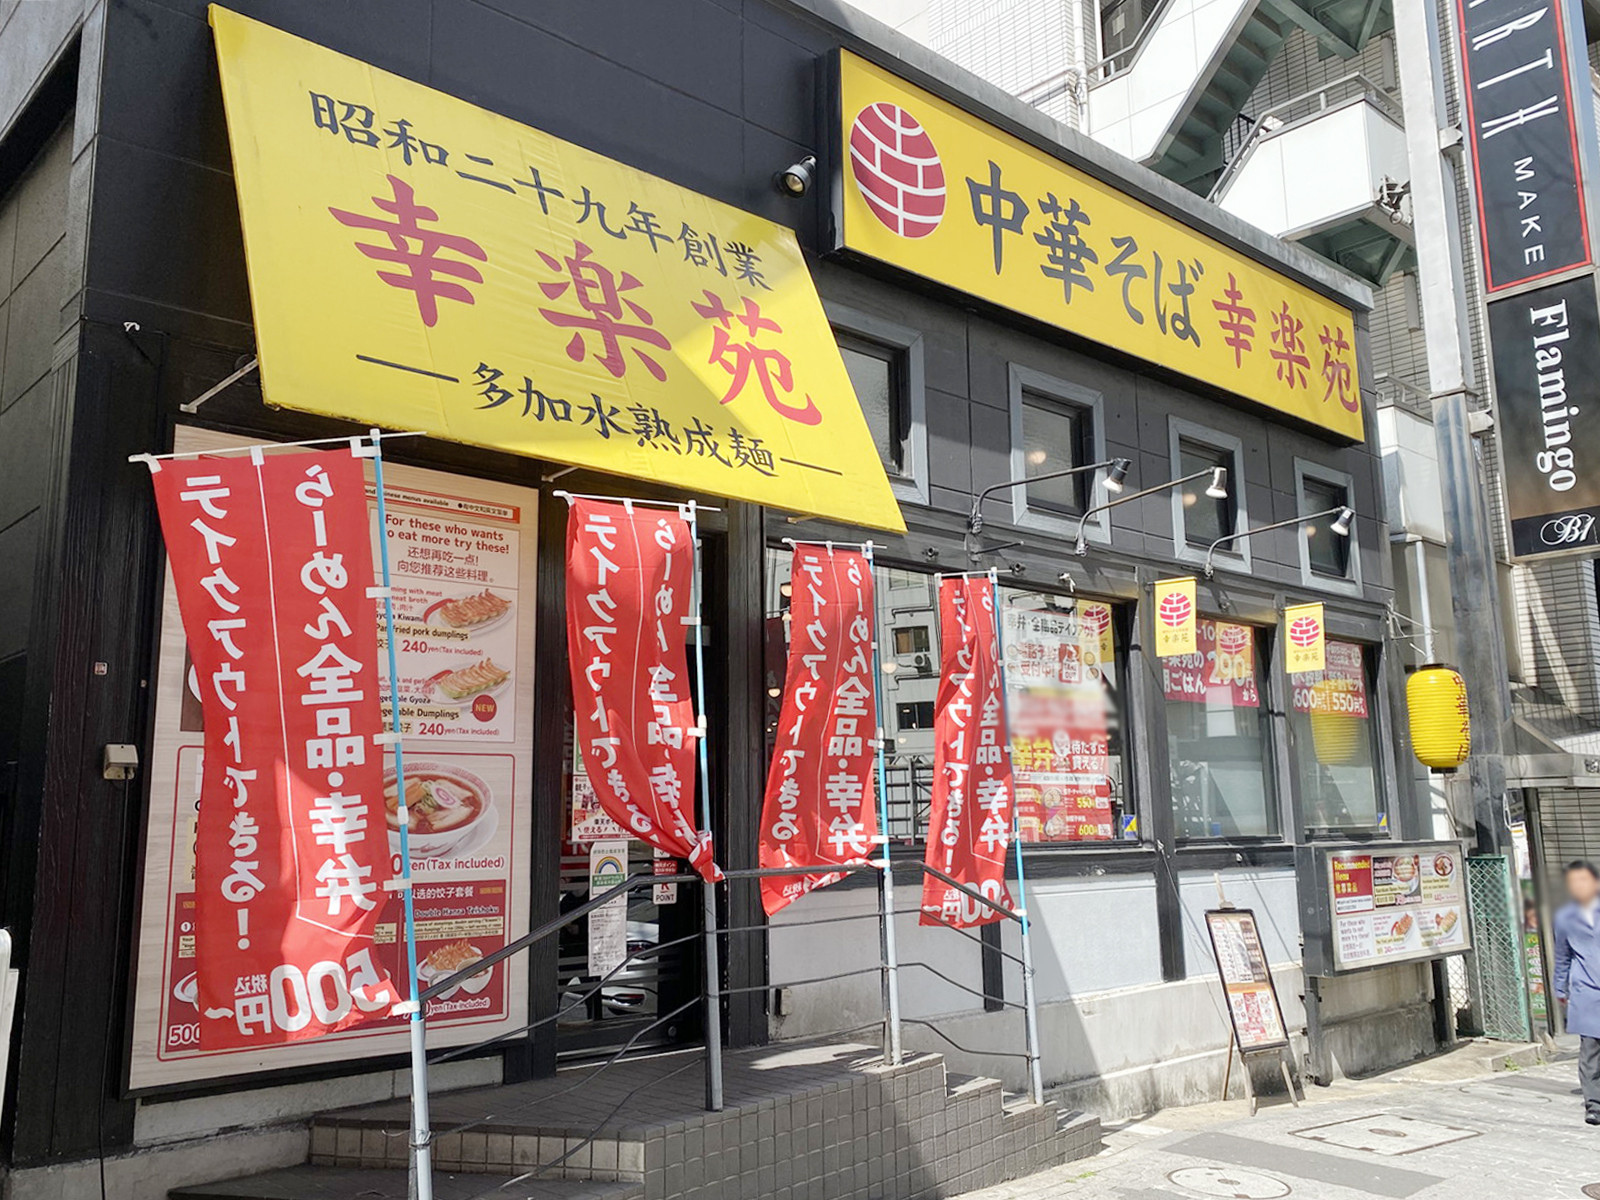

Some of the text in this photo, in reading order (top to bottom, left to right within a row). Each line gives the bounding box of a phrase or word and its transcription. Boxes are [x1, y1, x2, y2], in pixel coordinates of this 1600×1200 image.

[1468, 0, 1560, 265] RTH MAKE
[308, 90, 774, 291] 昭和二十九年創業
[965, 160, 1359, 414] 中華そば 幸楽苑
[328, 174, 822, 425] 幸楽苑
[1529, 299, 1580, 492] Flamingo
[422, 498, 450, 506] available
[385, 514, 504, 541] For these who wants
[1540, 513, 1596, 546] B1
[386, 530, 510, 554] o eat more try these!
[409, 588, 424, 596] with
[425, 589, 443, 597] meat
[413, 628, 430, 639] pork
[432, 628, 468, 641] dumplings
[417, 708, 459, 721] Dumplings
[475, 704, 495, 713] NEW
[1071, 740, 1106, 755] 待たずに
[1072, 756, 1105, 771] 買える!
[409, 859, 451, 870] en(Tax
[454, 856, 504, 870] included)
[656, 894, 675, 902] POINT
[414, 908, 441, 918] Double
